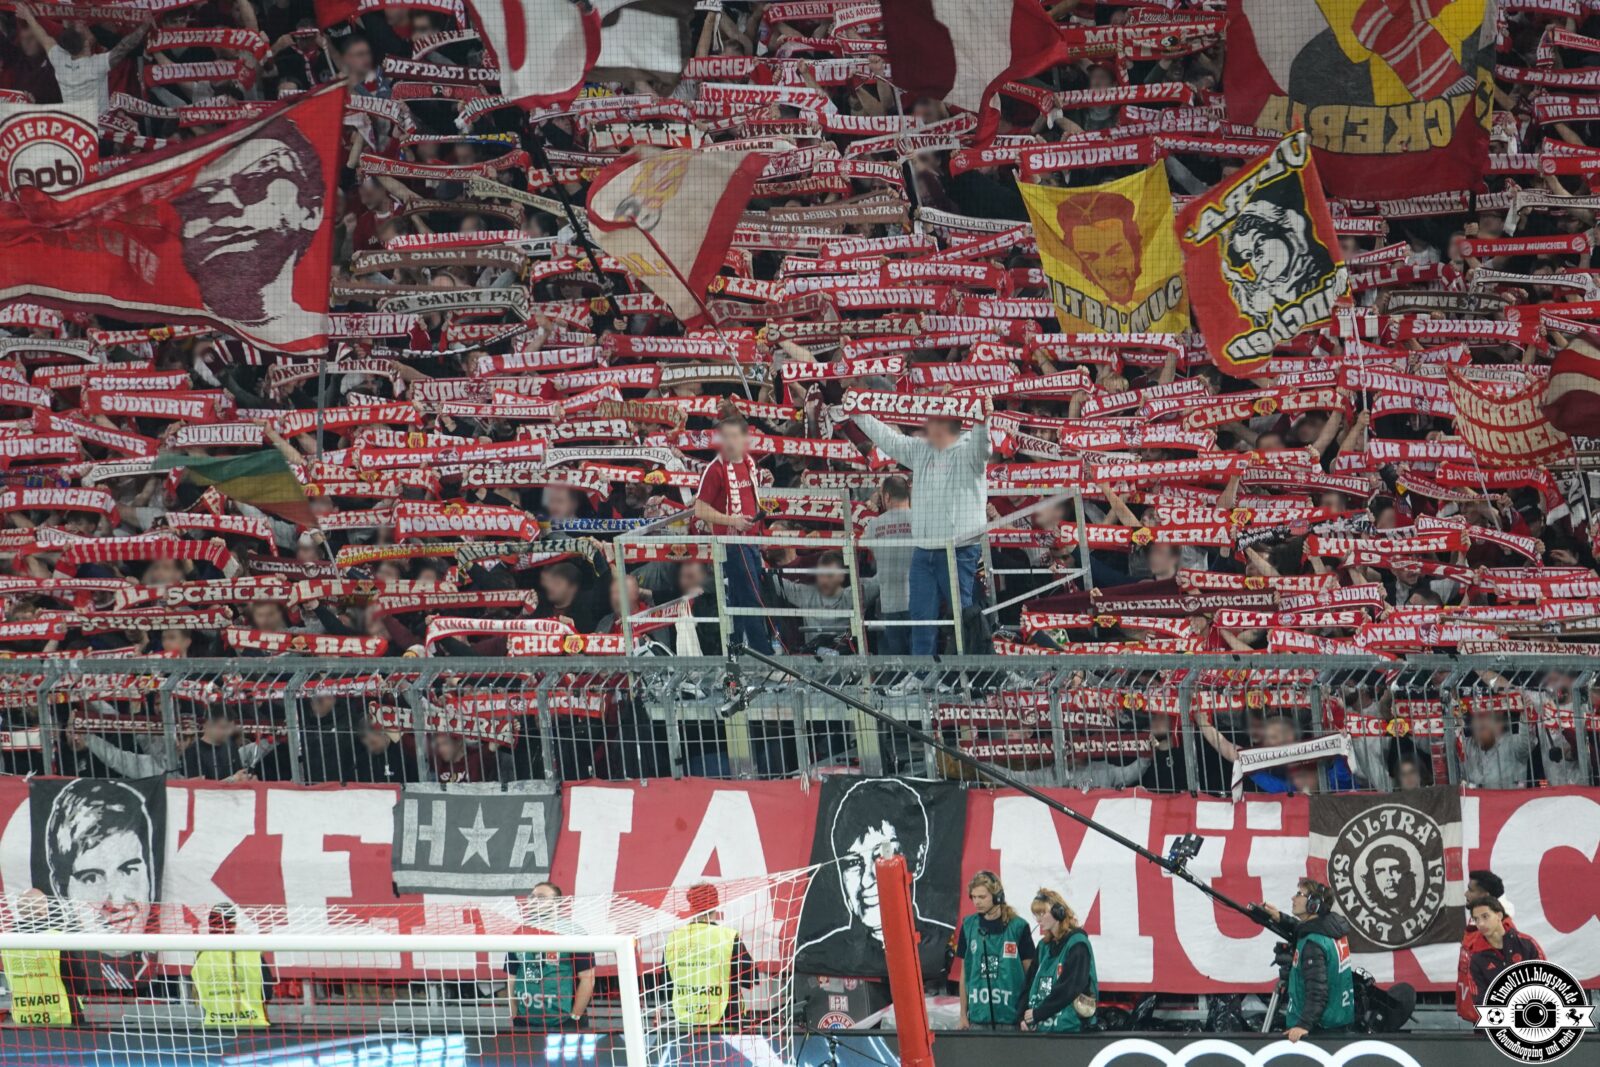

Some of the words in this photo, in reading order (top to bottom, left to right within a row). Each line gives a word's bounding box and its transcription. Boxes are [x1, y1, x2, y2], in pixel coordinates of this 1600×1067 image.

[1345, 368, 1448, 400] SÜDKURVE
[843, 390, 984, 421] SCHICKERIA
[1447, 468, 1490, 481] BAYERN
[1060, 525, 1130, 543] SCHIC
[478, 618, 497, 631] OF
[501, 619, 527, 632] THE
[533, 621, 561, 634] CUP
[1221, 612, 1273, 627] ULT
[1300, 612, 1357, 625] RAS
[968, 989, 1012, 1006] HOST
[18, 1012, 52, 1026] 4128
